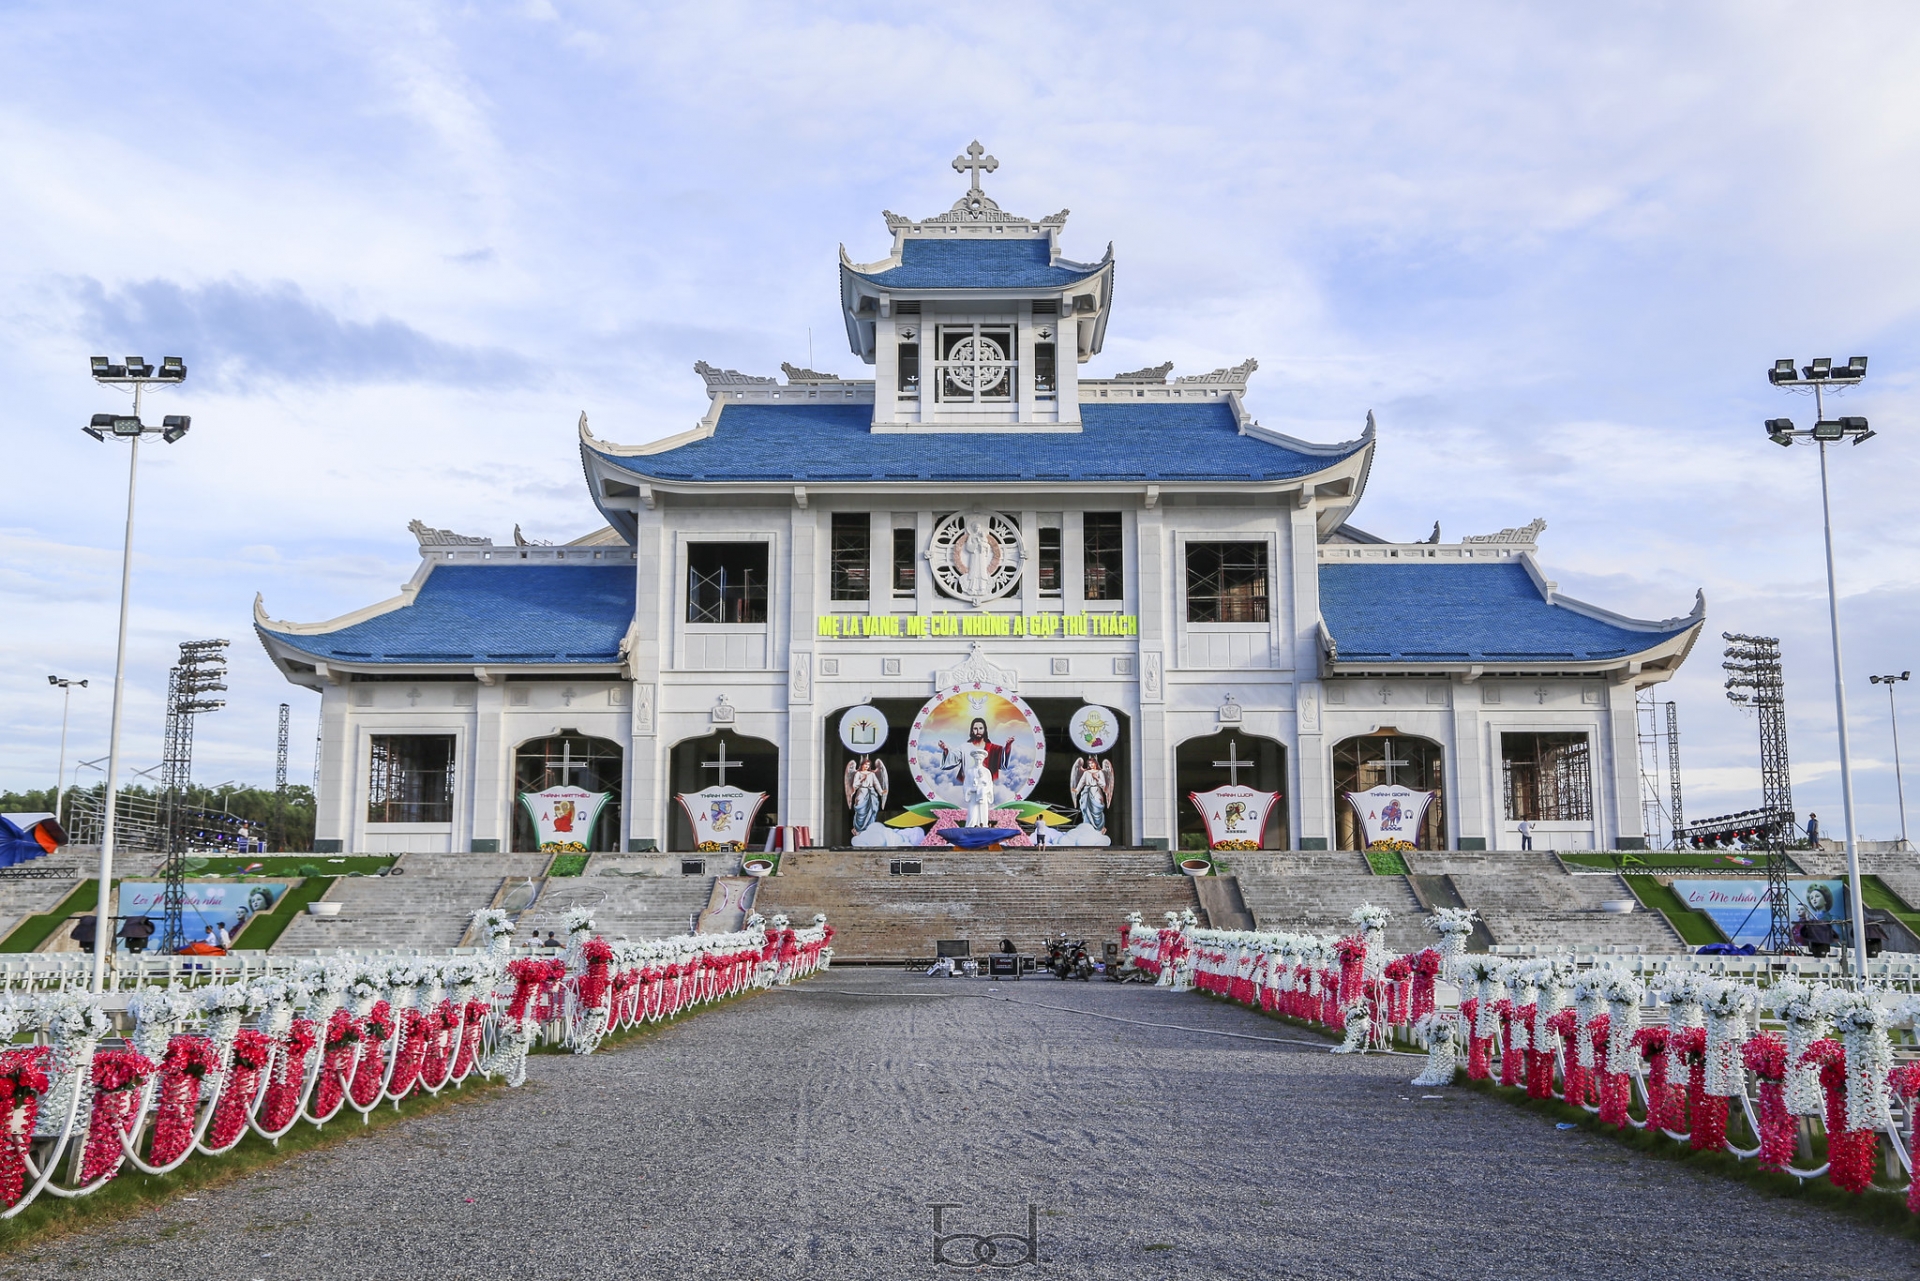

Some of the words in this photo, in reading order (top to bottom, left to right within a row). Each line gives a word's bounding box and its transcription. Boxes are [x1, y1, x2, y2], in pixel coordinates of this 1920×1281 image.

[818, 615, 840, 639] MẸ
[842, 615, 859, 636] LA
[862, 615, 904, 637] VANG,
[906, 615, 928, 639] MẸ
[931, 610, 959, 636] CỦA
[1013, 615, 1027, 636] AI
[1030, 611, 1059, 639] GẶP
[1091, 611, 1137, 636] THÁCH
